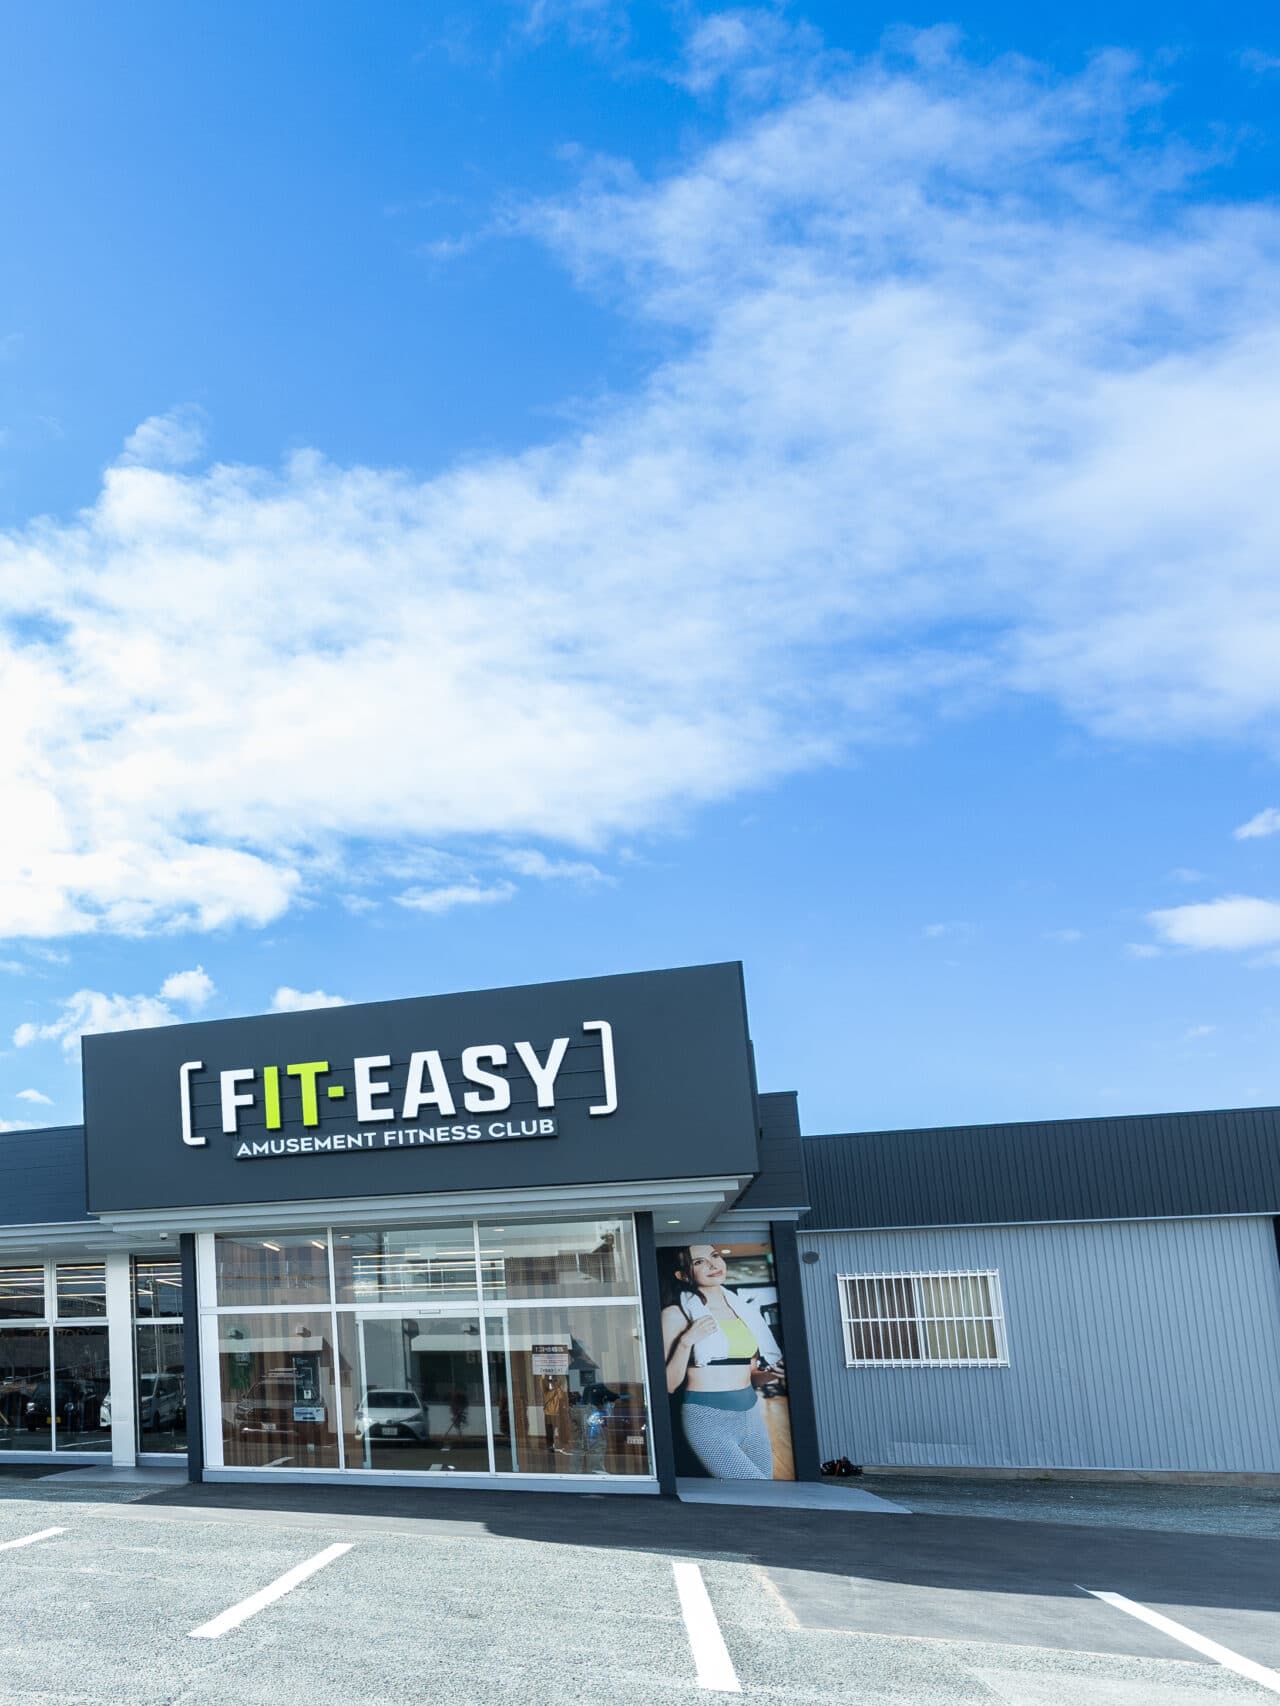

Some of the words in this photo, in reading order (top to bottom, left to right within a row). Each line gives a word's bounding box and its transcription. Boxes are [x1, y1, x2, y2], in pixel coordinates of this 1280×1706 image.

[236, 1131, 377, 1157] AMUSEMENT
[383, 1124, 482, 1146] FITNESS
[487, 1118, 555, 1138] CLUB
